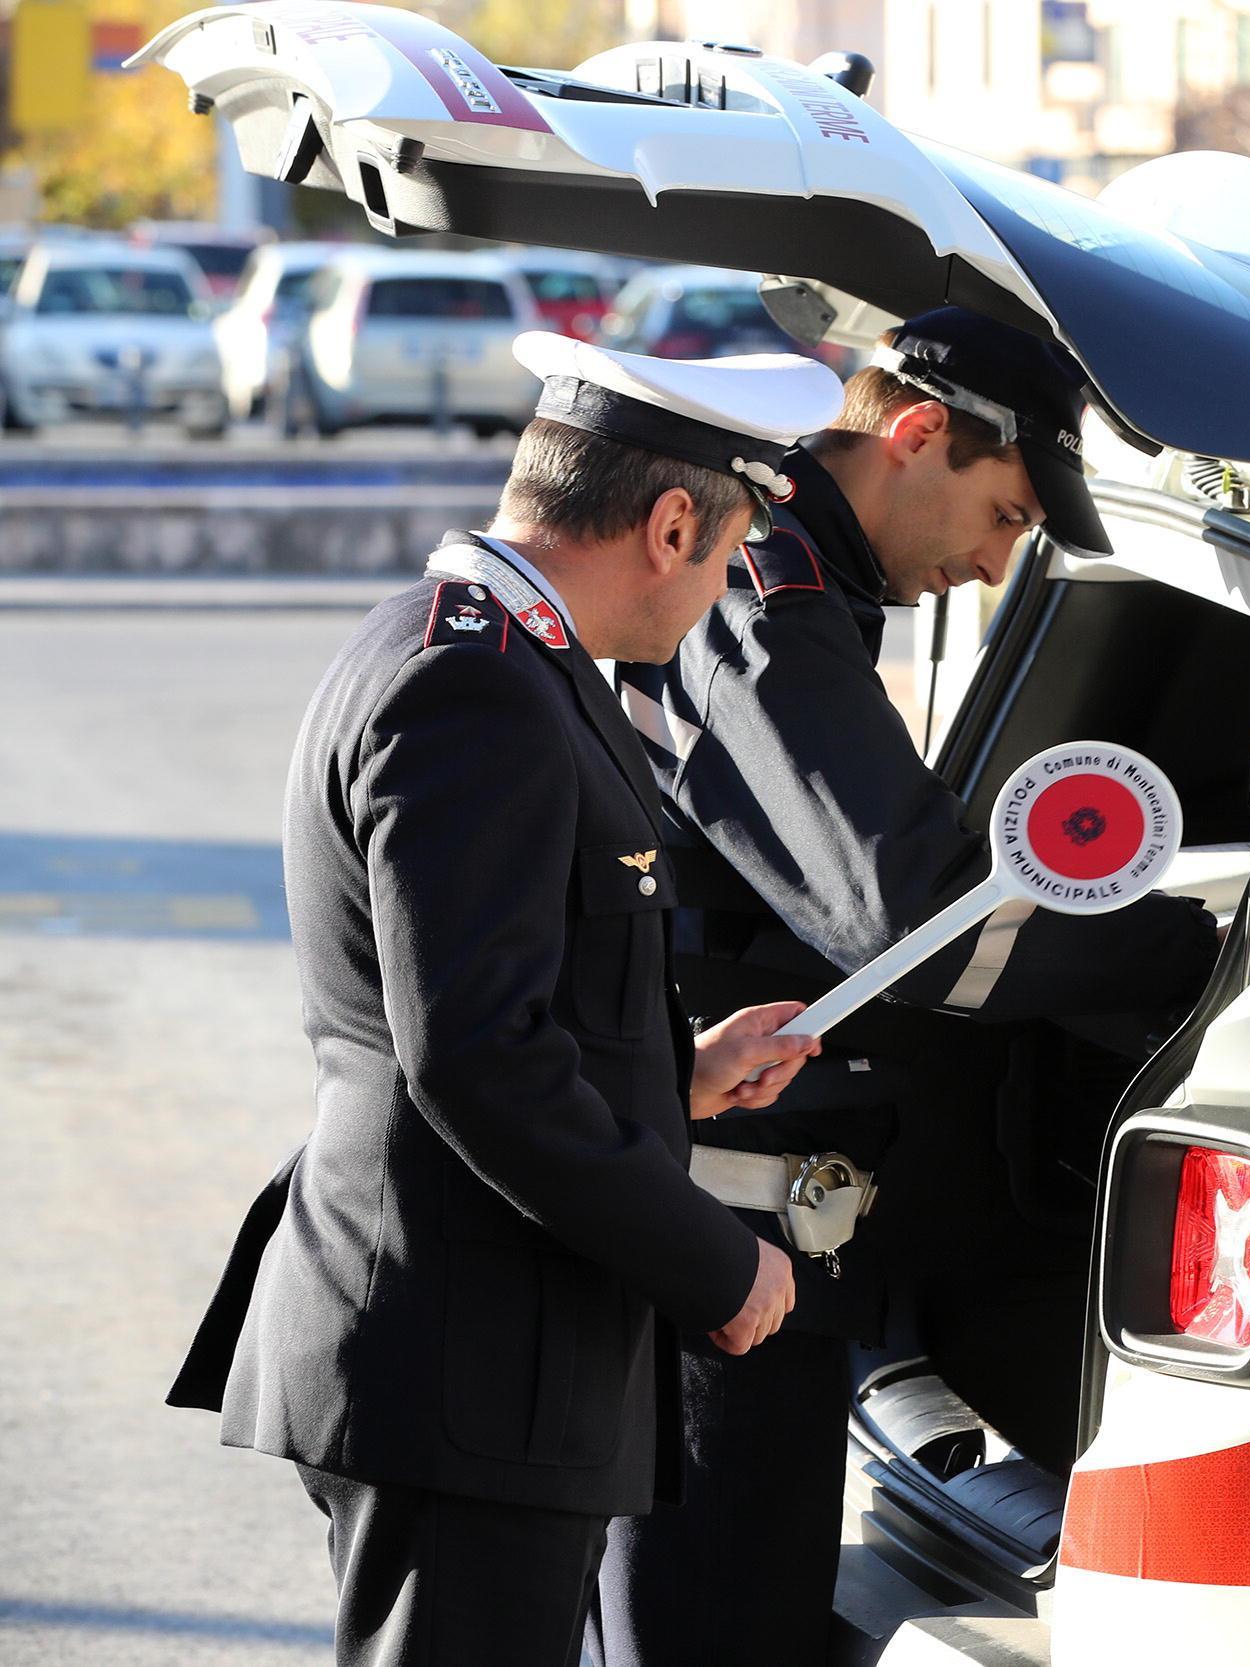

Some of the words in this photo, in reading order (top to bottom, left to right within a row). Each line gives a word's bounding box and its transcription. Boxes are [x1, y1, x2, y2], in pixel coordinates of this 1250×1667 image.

[1004, 777, 1036, 845] POLIZIA
[1043, 755, 1101, 774] Comune
[1106, 756, 1120, 771] di
[1130, 842, 1164, 878] Terme
[1010, 850, 1122, 900] MUNICIPALE
